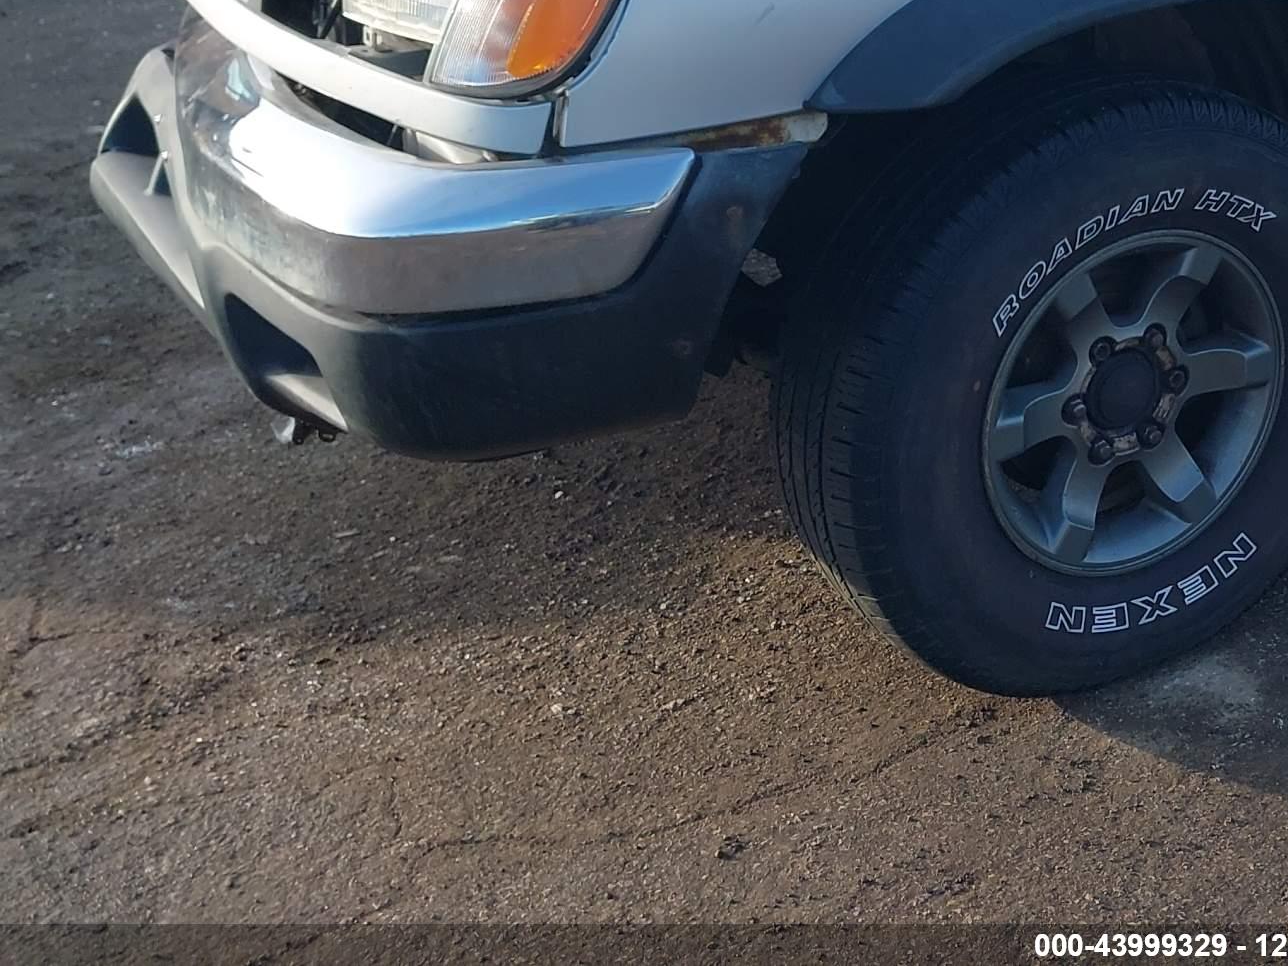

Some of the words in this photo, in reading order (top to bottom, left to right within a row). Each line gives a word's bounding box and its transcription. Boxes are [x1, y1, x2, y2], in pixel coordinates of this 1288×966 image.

[991, 187, 1185, 337] ROADIAN
[1194, 188, 1278, 232] HTX
[1045, 532, 1258, 634] NEXEN
